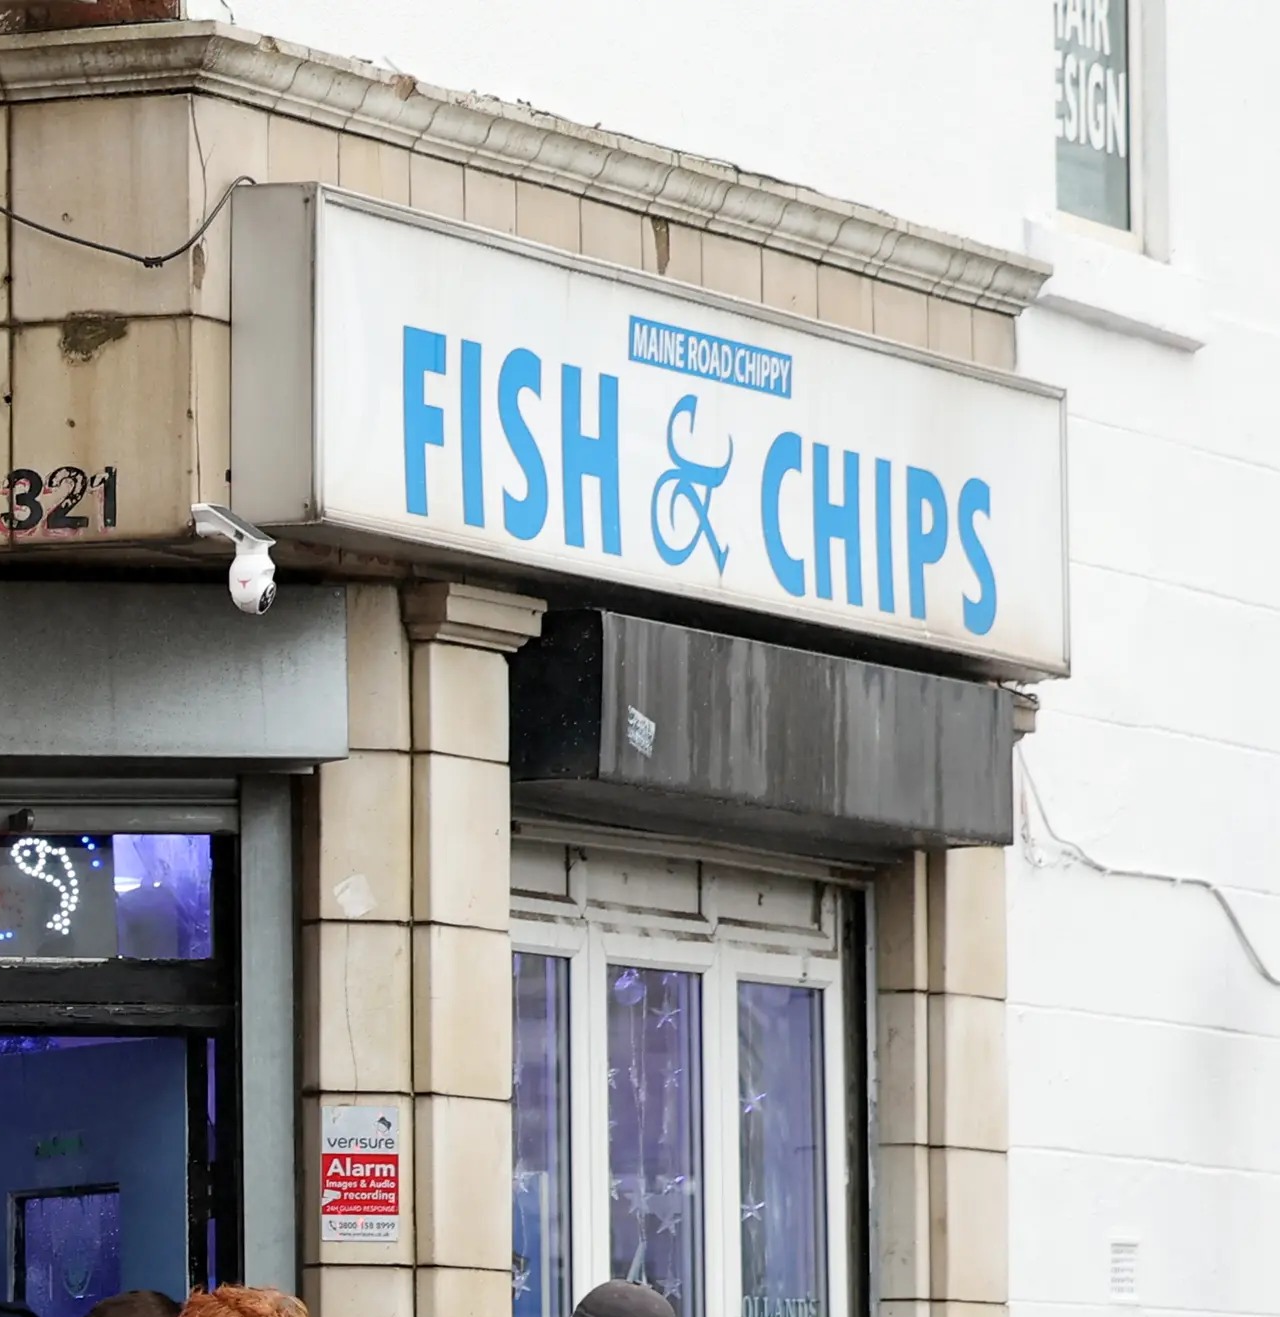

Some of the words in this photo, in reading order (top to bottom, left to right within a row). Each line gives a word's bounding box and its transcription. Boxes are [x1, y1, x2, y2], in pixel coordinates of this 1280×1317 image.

[1055, 0, 1111, 56] AIR
[633, 322, 685, 369] MAINE
[687, 335, 733, 379] ROAD
[734, 349, 791, 393] CHIPPY
[402, 325, 622, 557] FISH
[649, 394, 733, 577] &
[759, 430, 998, 637] CHIPS
[327, 1136, 395, 1149] verisure
[327, 1157, 396, 1177] Alarm
[326, 1179, 358, 1191] Images
[359, 1179, 367, 1189] &
[369, 1179, 396, 1189] Audio
[343, 1189, 396, 1203] recording
[326, 1204, 339, 1213] 24H
[340, 1204, 362, 1213] GUARD
[363, 1204, 395, 1213] RESPONSE
